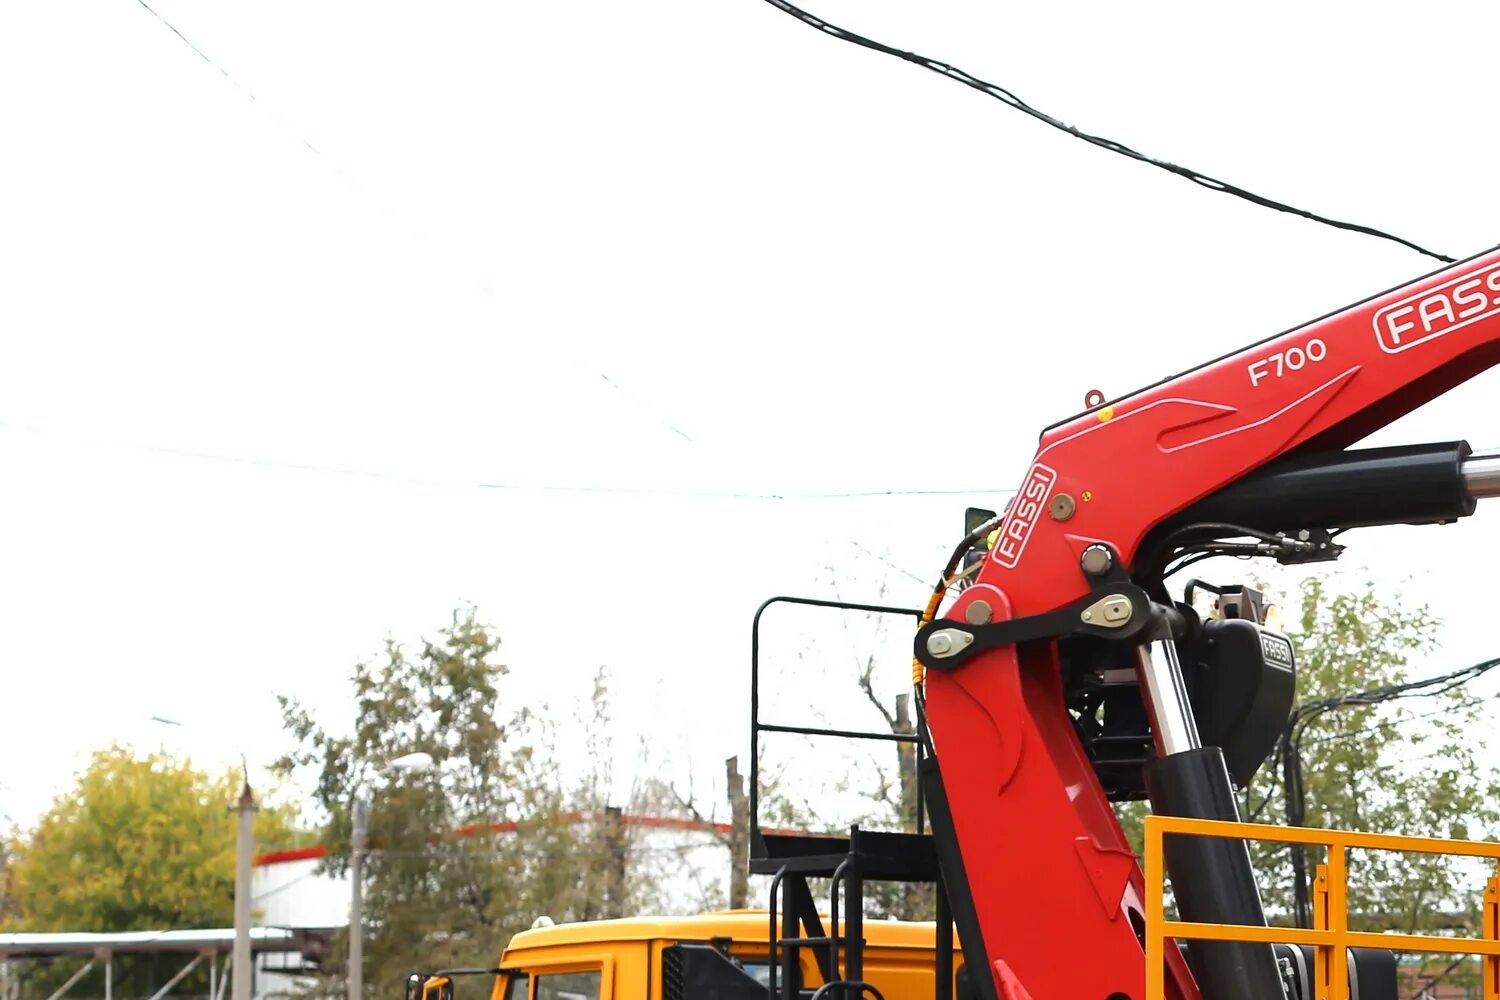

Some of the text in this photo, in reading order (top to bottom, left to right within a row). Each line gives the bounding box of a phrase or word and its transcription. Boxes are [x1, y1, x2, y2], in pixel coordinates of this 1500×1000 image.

[1247, 337, 1328, 387] F700
[998, 470, 1051, 560] FASSI
[1262, 638, 1290, 663] FASSI
